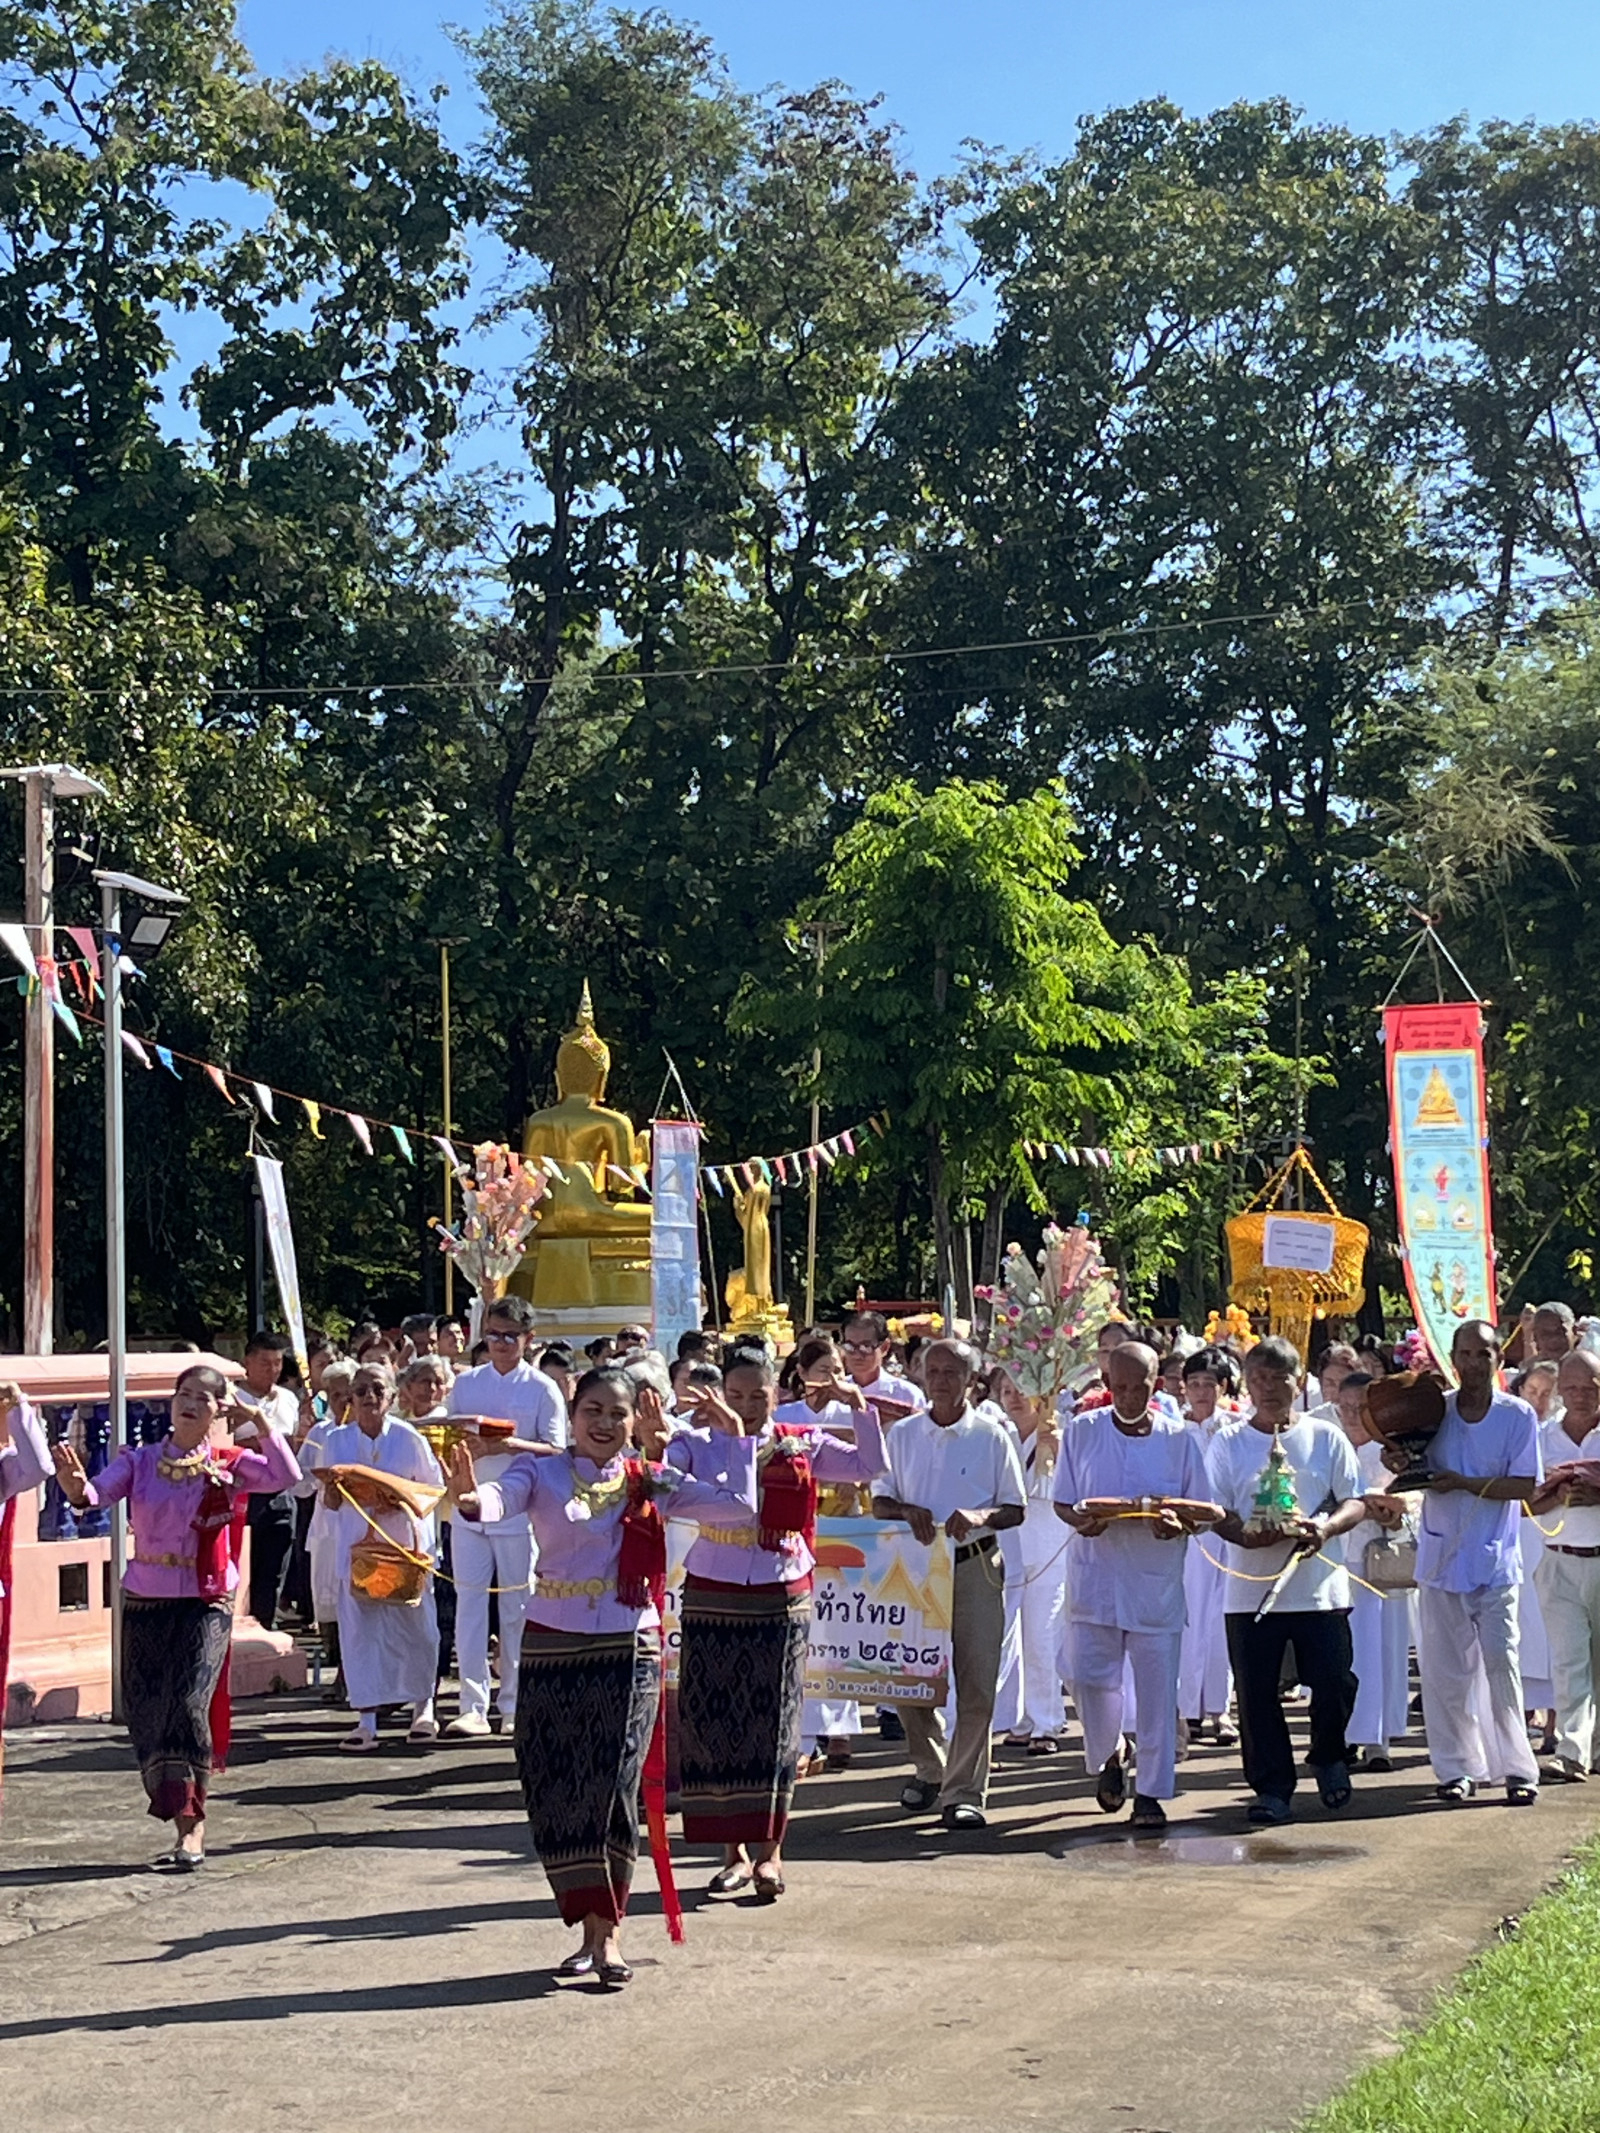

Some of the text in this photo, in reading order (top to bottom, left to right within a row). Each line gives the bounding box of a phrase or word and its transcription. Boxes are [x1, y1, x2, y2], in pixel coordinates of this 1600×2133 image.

[814, 1582, 906, 1625] ทั่วไทย
[858, 1640, 940, 1665] ๒๕๖๘
